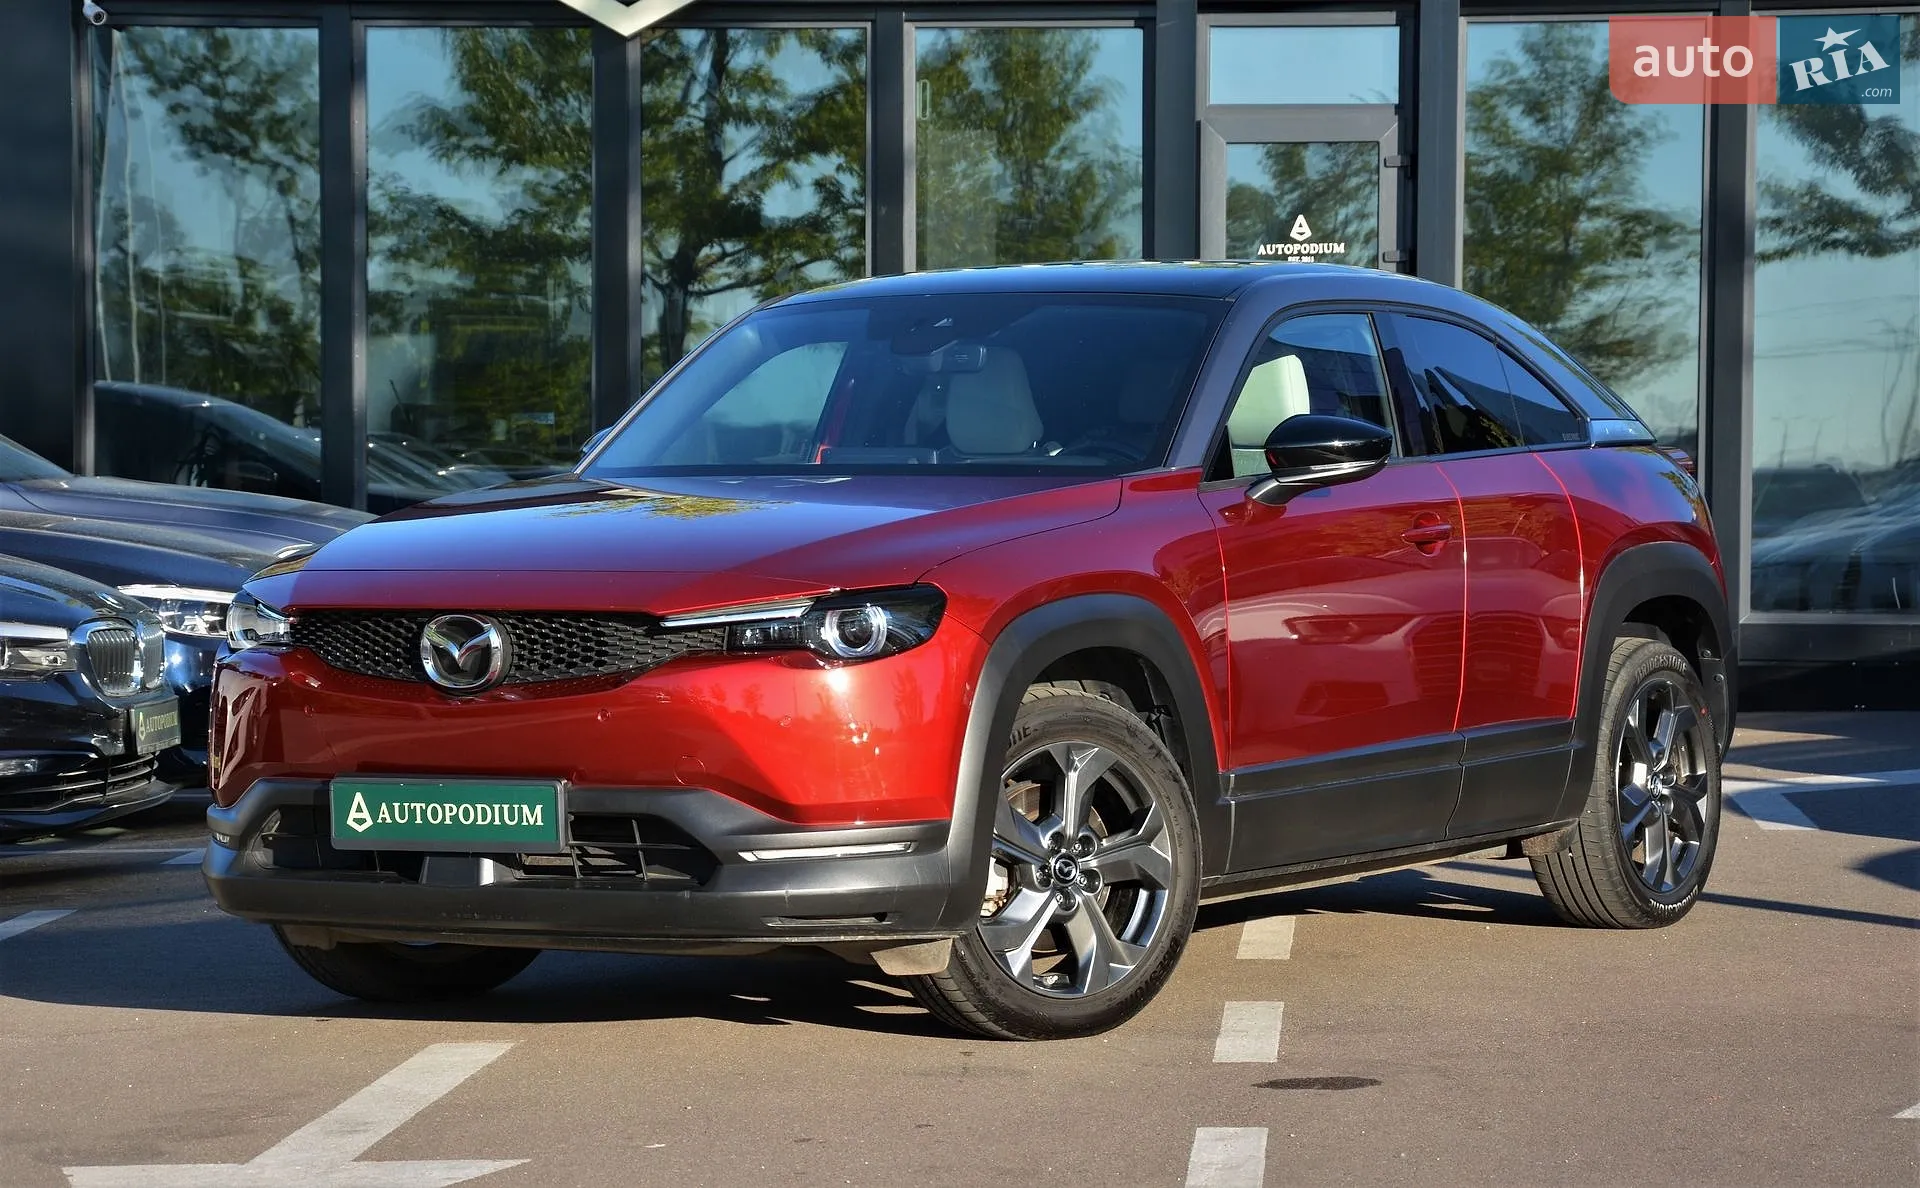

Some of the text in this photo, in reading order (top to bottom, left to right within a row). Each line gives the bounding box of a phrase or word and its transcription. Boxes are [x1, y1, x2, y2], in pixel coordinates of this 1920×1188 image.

[1257, 242, 1345, 255] AUTOPODIUM
[1635, 654, 1687, 684] BRIDGESTONE
[146, 712, 178, 733] AUTOPODIUM
[376, 802, 544, 826] AUTOPODIUM
